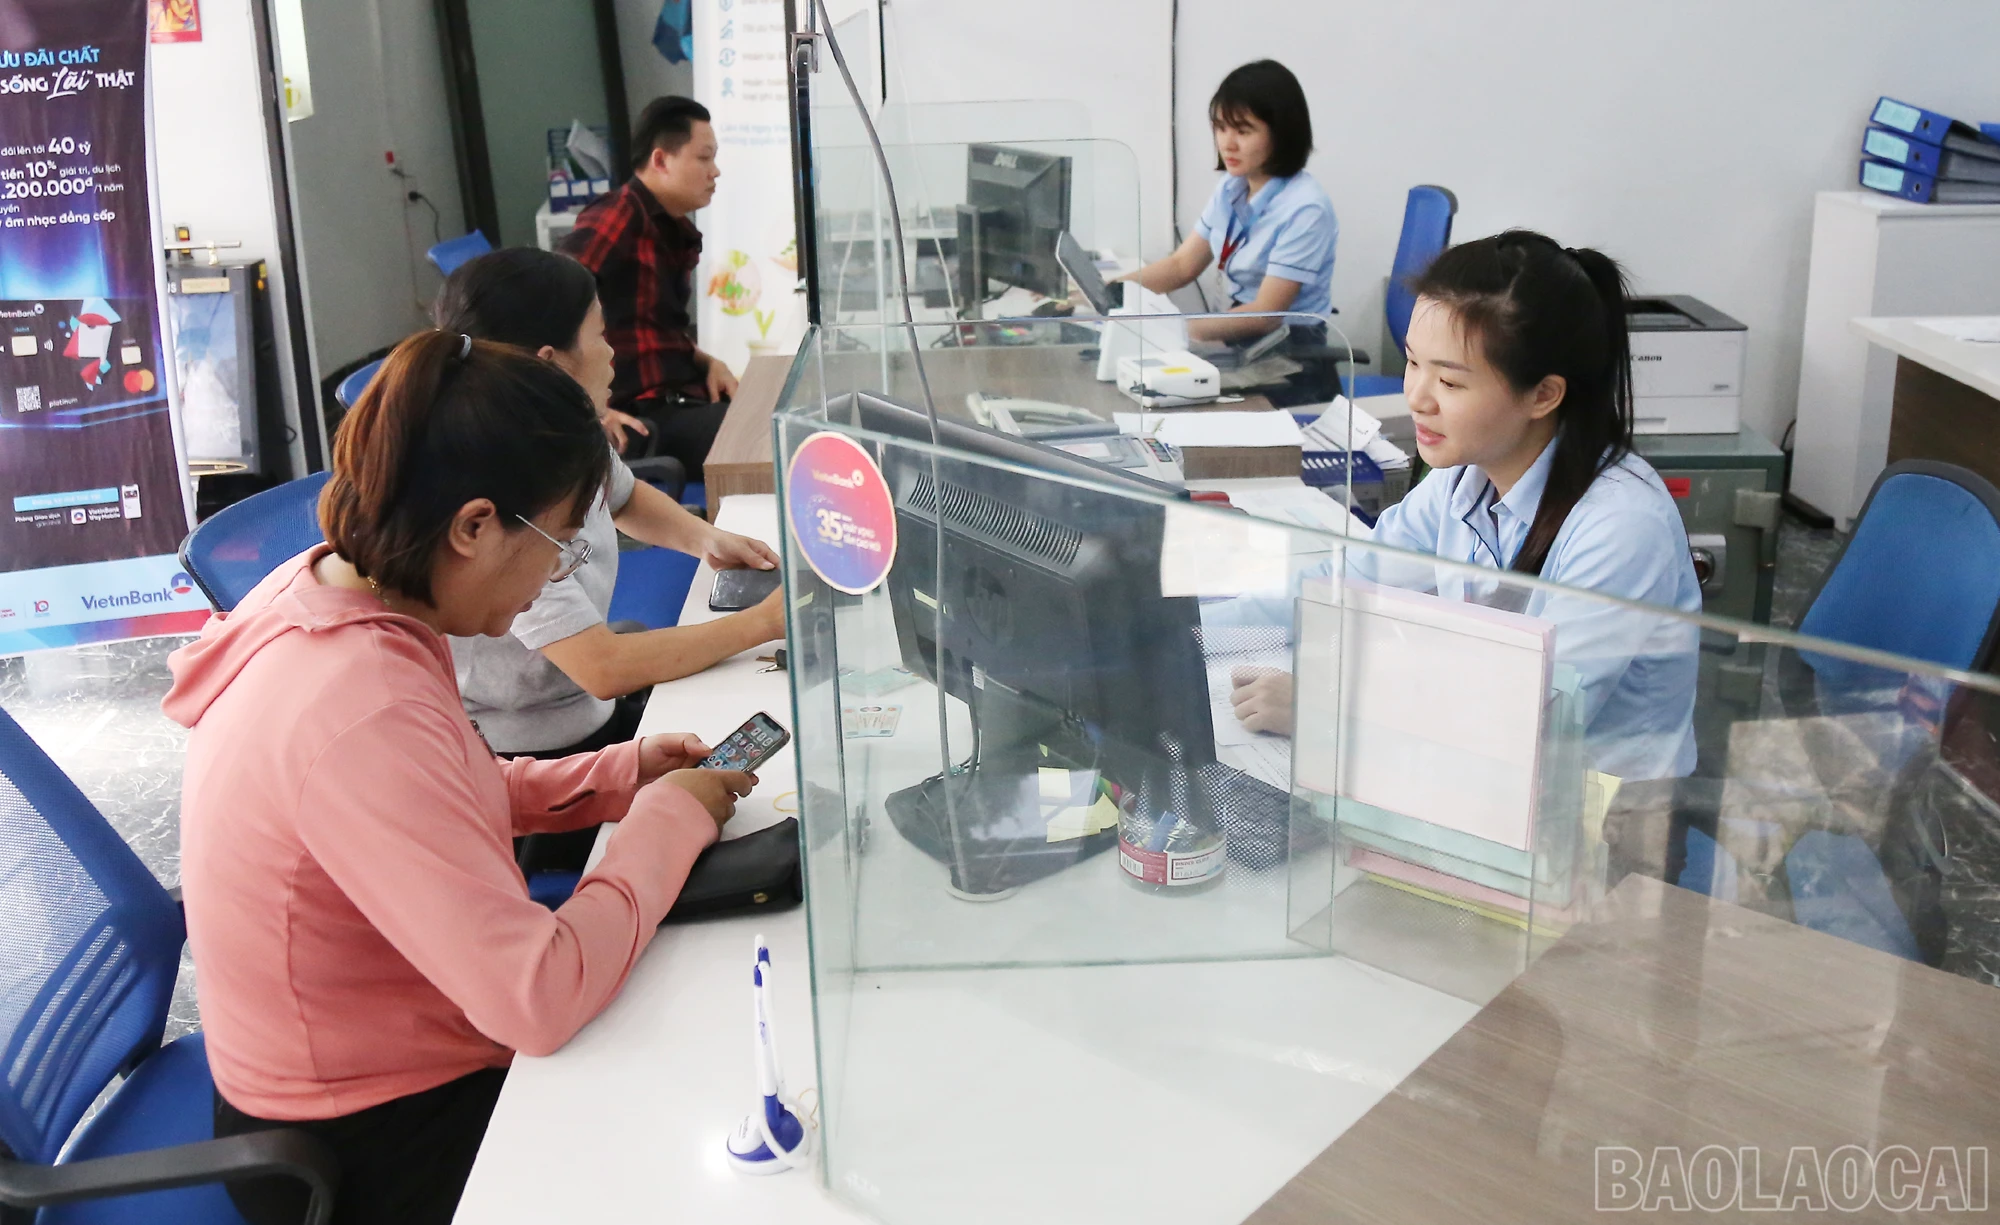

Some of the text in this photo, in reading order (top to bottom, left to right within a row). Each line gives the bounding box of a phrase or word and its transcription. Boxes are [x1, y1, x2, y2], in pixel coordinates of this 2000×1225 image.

[24, 48, 54, 66] ĐÃI
[58, 45, 100, 64] CHẤT
[1, 73, 49, 94] SỐNG
[95, 69, 135, 90] THẬT
[48, 136, 75, 155] 40
[25, 160, 58, 179] 10%
[5, 216, 25, 228] âm
[26, 214, 57, 228] nhạc
[93, 209, 116, 222] cấp
[49, 398, 78, 408] platinum
[816, 508, 843, 541] 35
[82, 587, 173, 611] VietinBank
